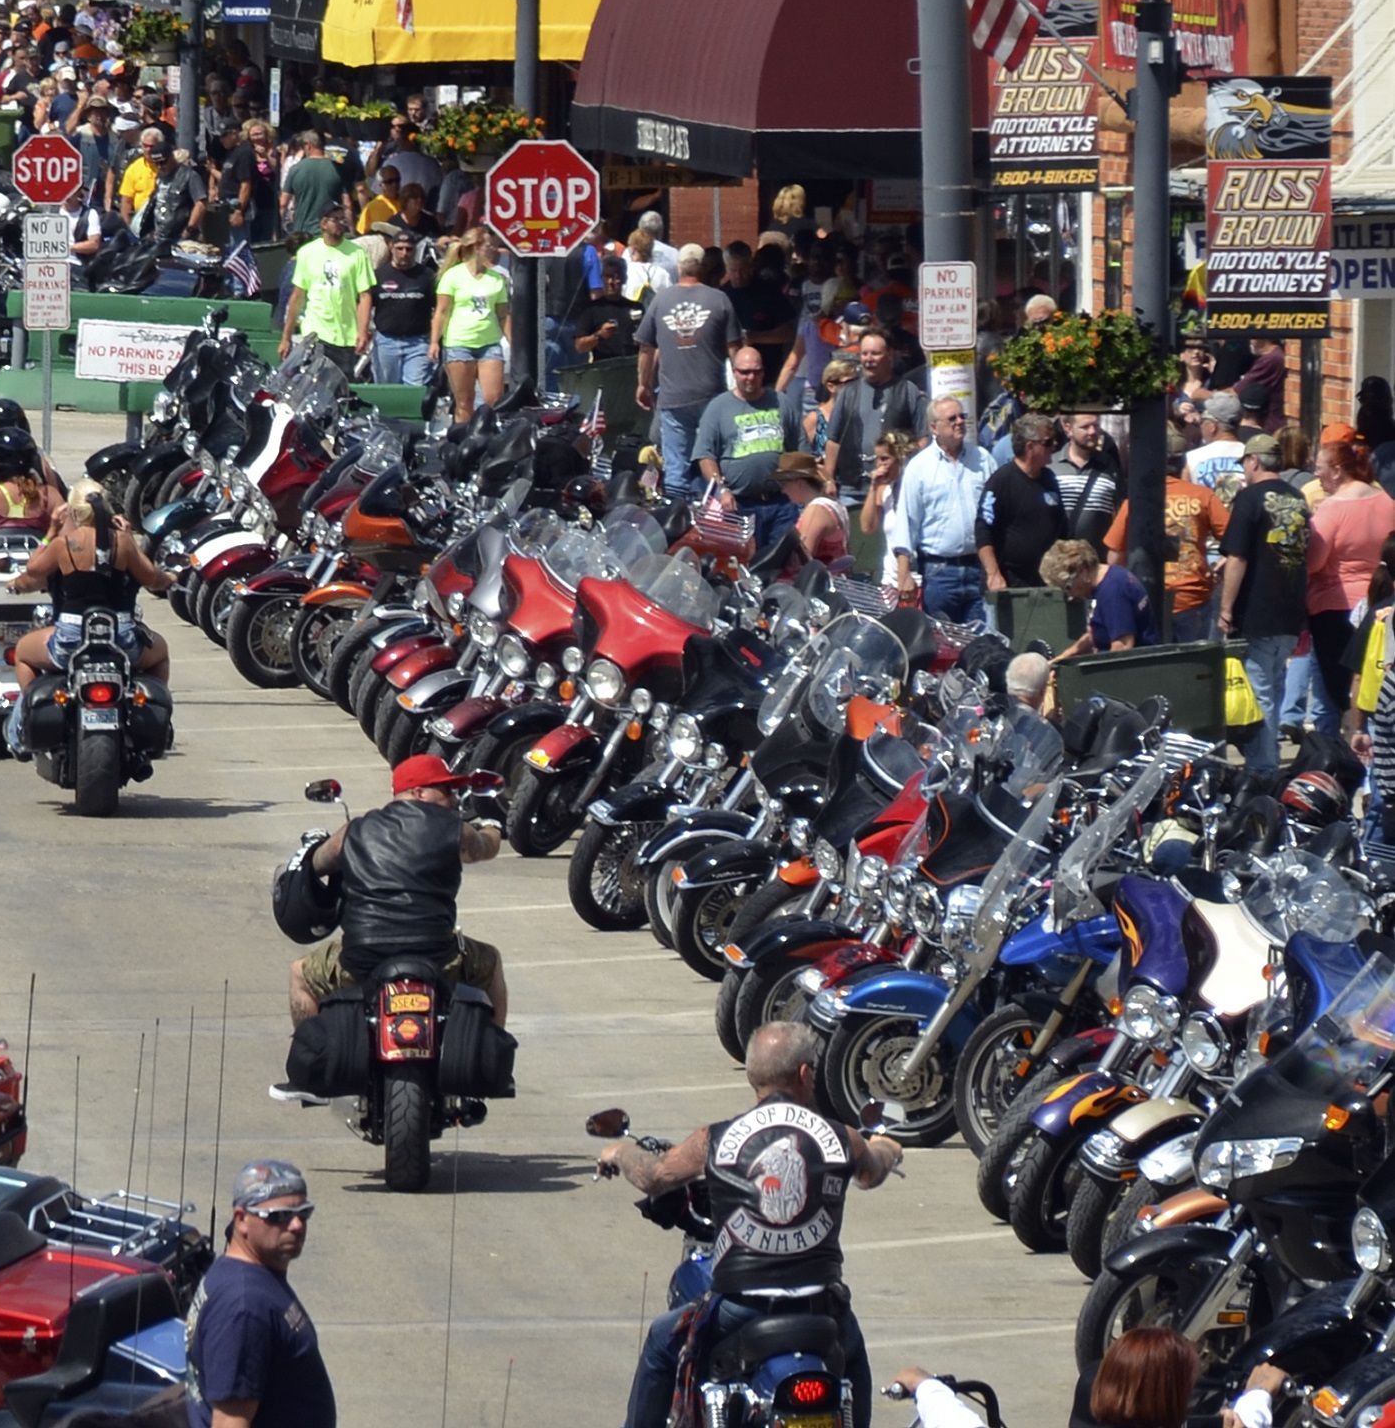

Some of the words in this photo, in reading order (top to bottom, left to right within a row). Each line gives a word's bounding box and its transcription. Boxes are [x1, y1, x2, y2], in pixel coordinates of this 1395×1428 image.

[997, 85, 1091, 113] BROWN
[990, 117, 1098, 134] MOTORCYCLE
[994, 135, 1095, 154] ATTORNEYS
[15, 156, 79, 184] STOP
[1217, 168, 1322, 210] RUSS
[495, 177, 591, 220] STOP
[31, 222, 47, 235] NO
[55, 223, 63, 234] U
[1214, 216, 1323, 247] BROWN
[29, 241, 67, 254] TURNS
[1208, 251, 1331, 270] MOTORCYCLE
[38, 266, 55, 277] NO
[937, 270, 957, 283] NO
[29, 280, 67, 290] PARKING
[1211, 273, 1327, 293] ATTORNEYS
[924, 287, 972, 299] PARKING
[1208, 313, 1328, 329] 1-800-4-BIKERS
[88, 346, 106, 357] NO
[110, 346, 163, 360] PARKING
[119, 363, 146, 375] THIS
[149, 364, 173, 376] BLO
[720, 1121, 753, 1161] SONS
[756, 1108, 777, 1125] OF
[784, 1106, 843, 1164] DESTINY
[826, 1177, 842, 1194] MC
[731, 1214, 833, 1252] DANMARK
